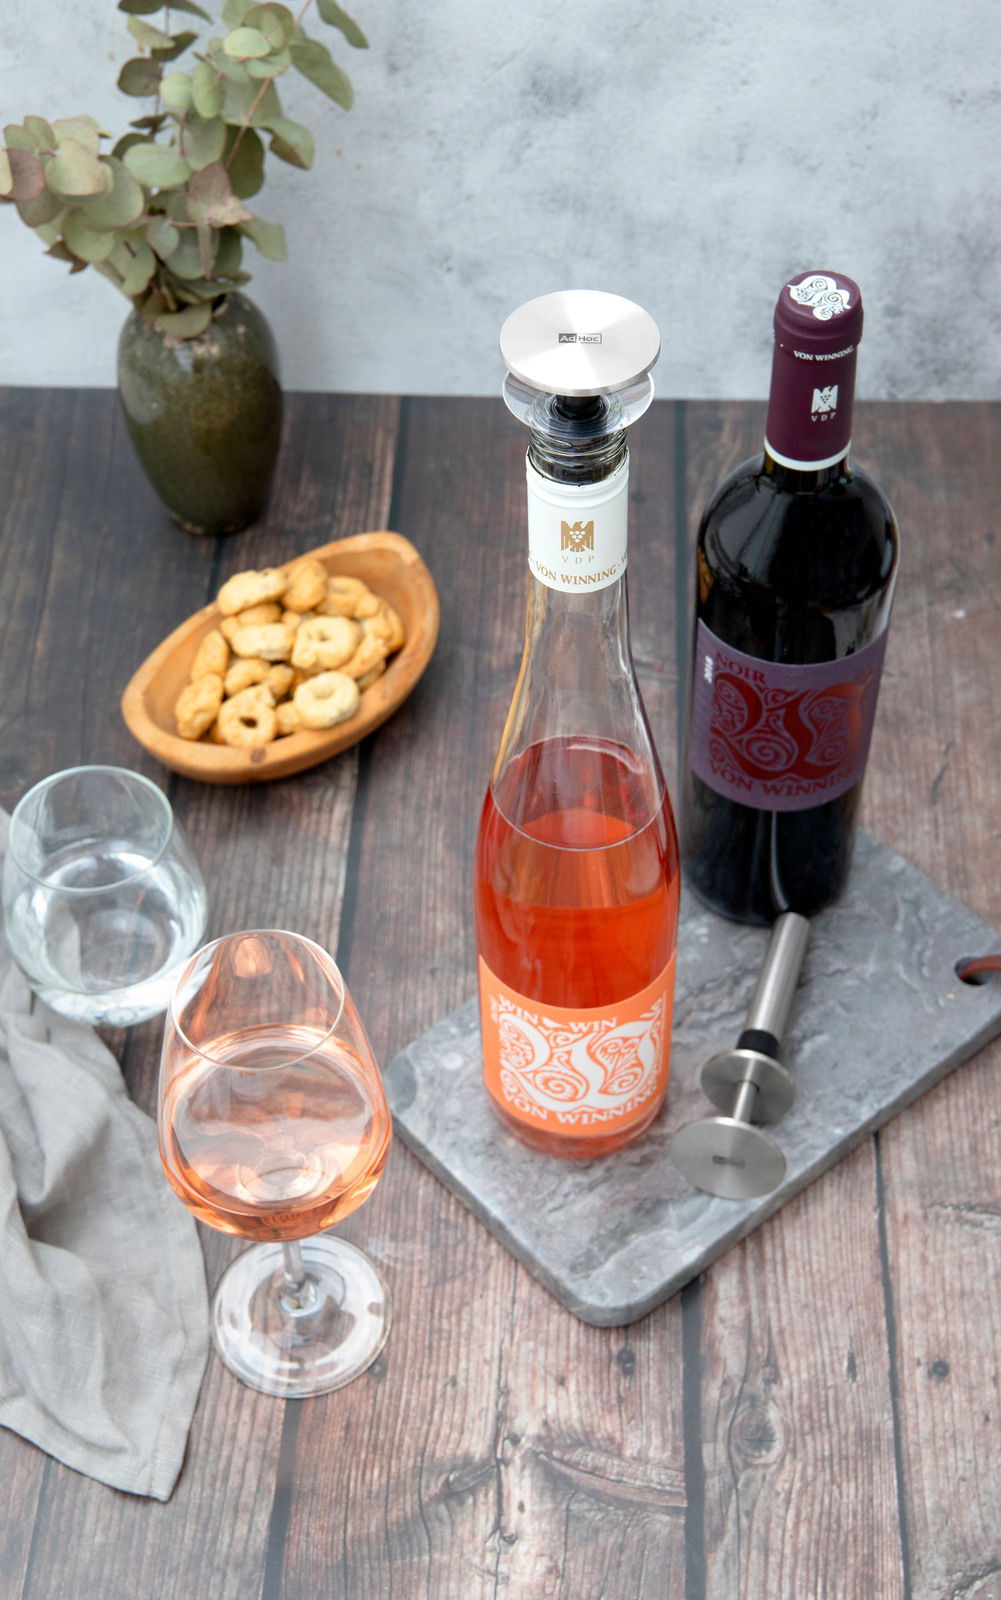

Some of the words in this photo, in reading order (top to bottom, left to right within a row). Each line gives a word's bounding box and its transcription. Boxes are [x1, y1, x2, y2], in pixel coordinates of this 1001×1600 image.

[793, 349, 813, 361] VON
[815, 345, 854, 361] WINNING
[536, 560, 557, 582] VON
[560, 564, 617, 585] WINNING
[715, 651, 767, 685] NOIR
[499, 994, 538, 1025] WIN
[568, 1016, 617, 1033] WIN
